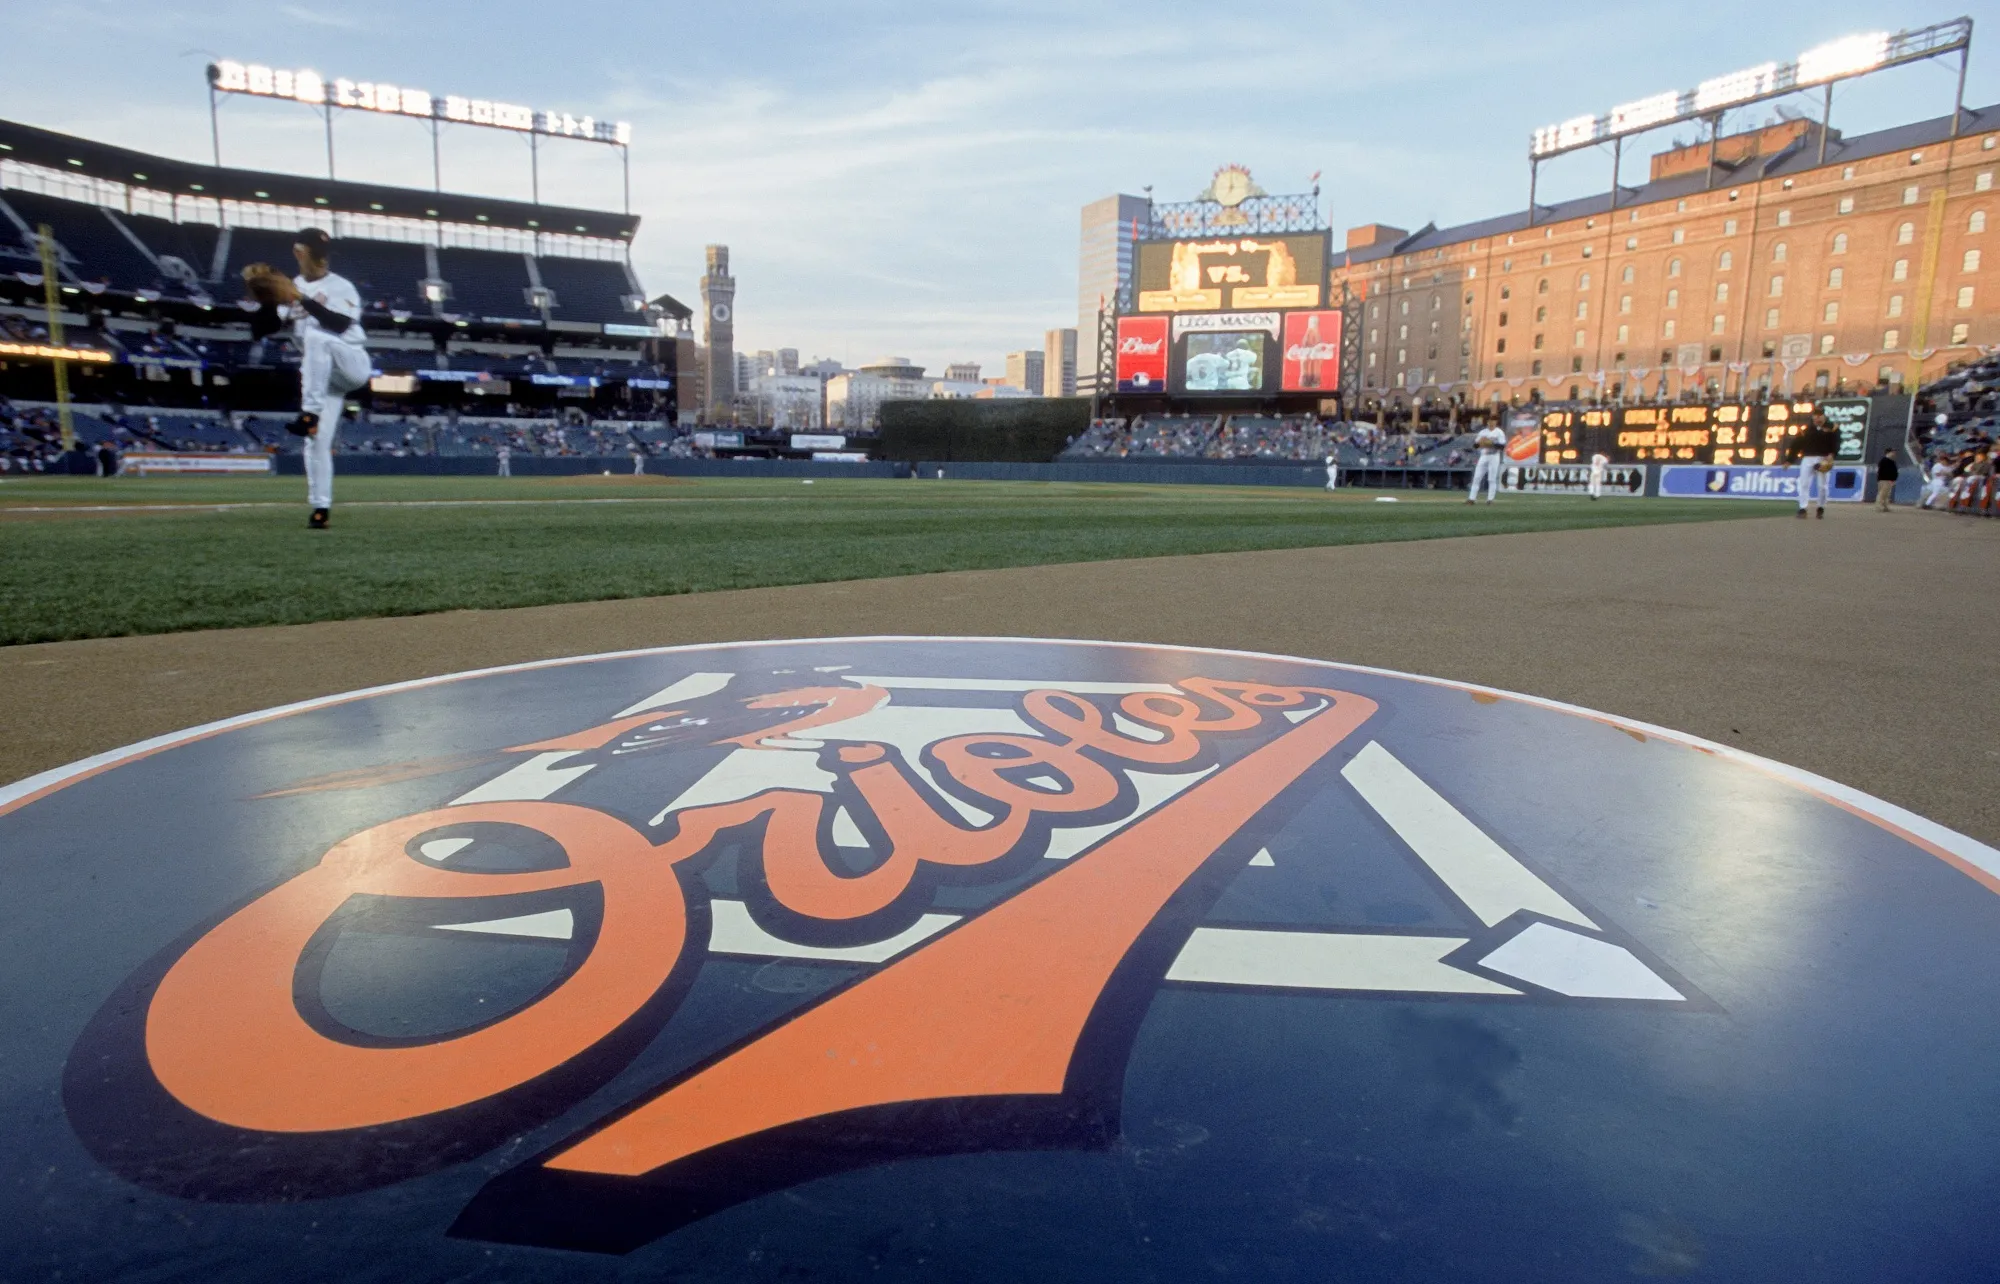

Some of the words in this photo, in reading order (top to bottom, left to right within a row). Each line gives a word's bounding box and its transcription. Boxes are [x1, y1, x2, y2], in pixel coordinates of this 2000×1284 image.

[1179, 316, 1215, 328] LEGG
[1220, 314, 1273, 326] MASON
[1120, 336, 1163, 355] Bud
[1525, 466, 1633, 484] UNIVERITY
[145, 677, 1380, 1177] Orioles
